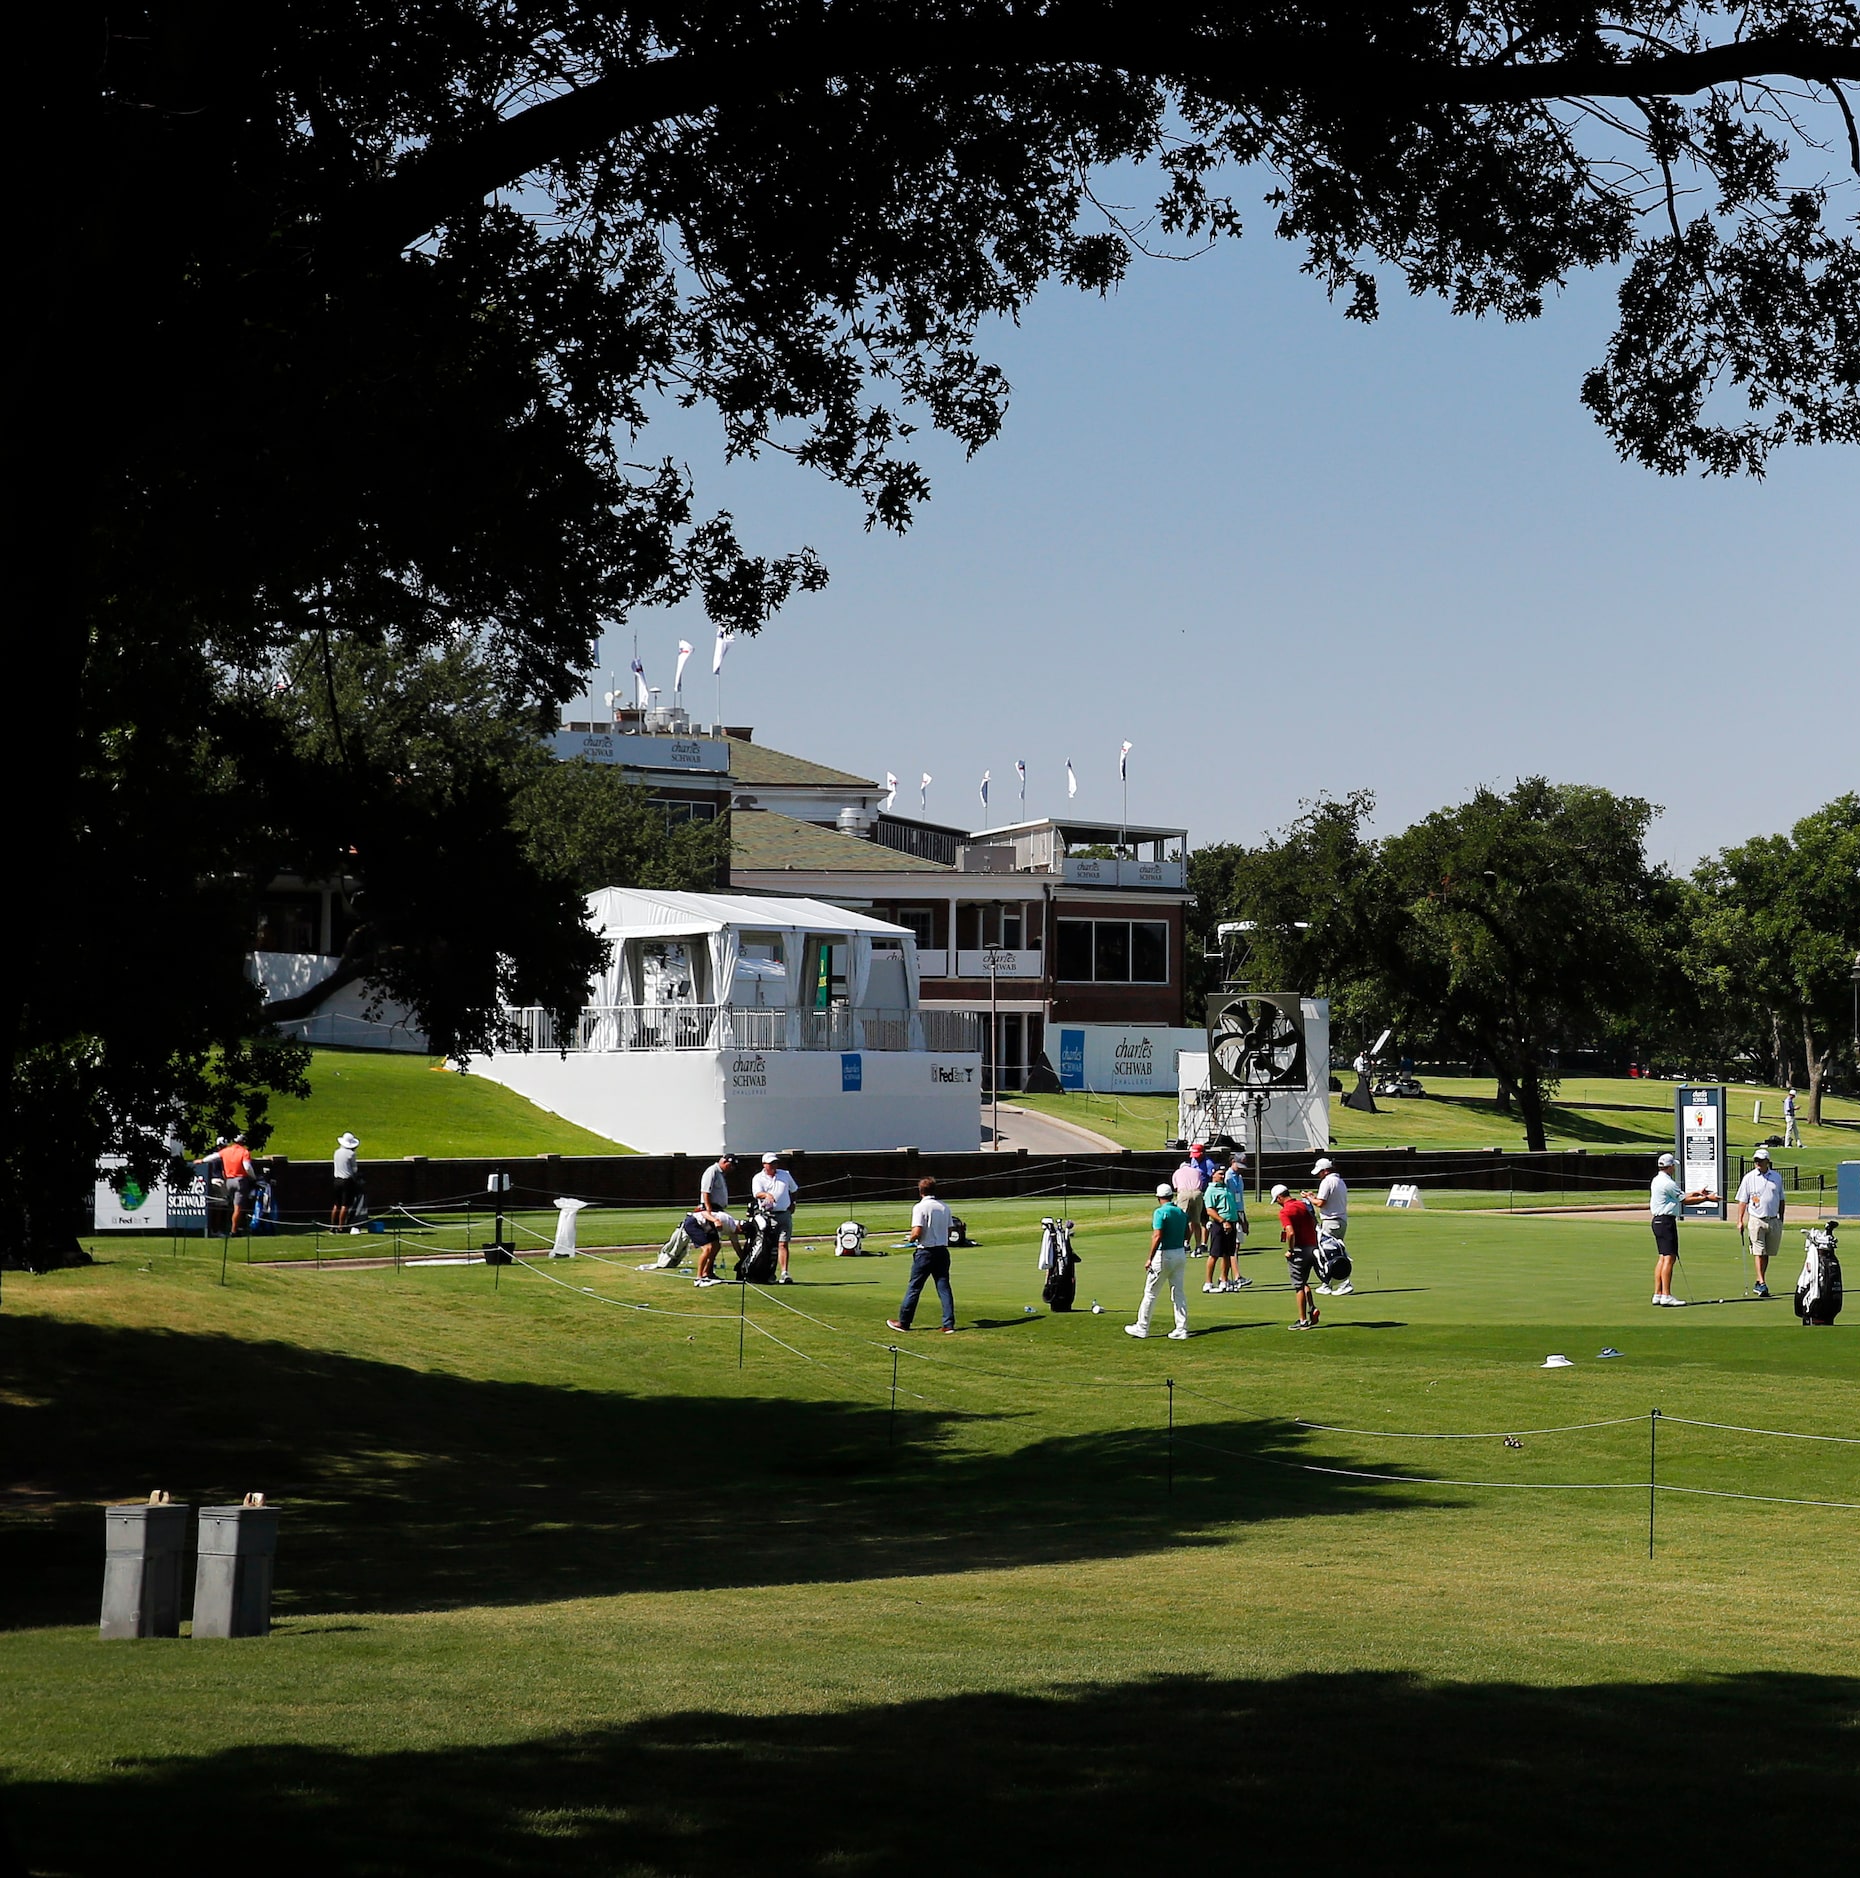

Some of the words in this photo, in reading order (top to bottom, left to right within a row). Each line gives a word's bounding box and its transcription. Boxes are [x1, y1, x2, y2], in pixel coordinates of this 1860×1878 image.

[1115, 1037, 1153, 1059] charles
[733, 1054, 766, 1073] charles
[1114, 1062, 1152, 1075] SCHWAB
[733, 1075, 766, 1088] SCHWAB
[168, 1195, 206, 1208] SCHWAB
